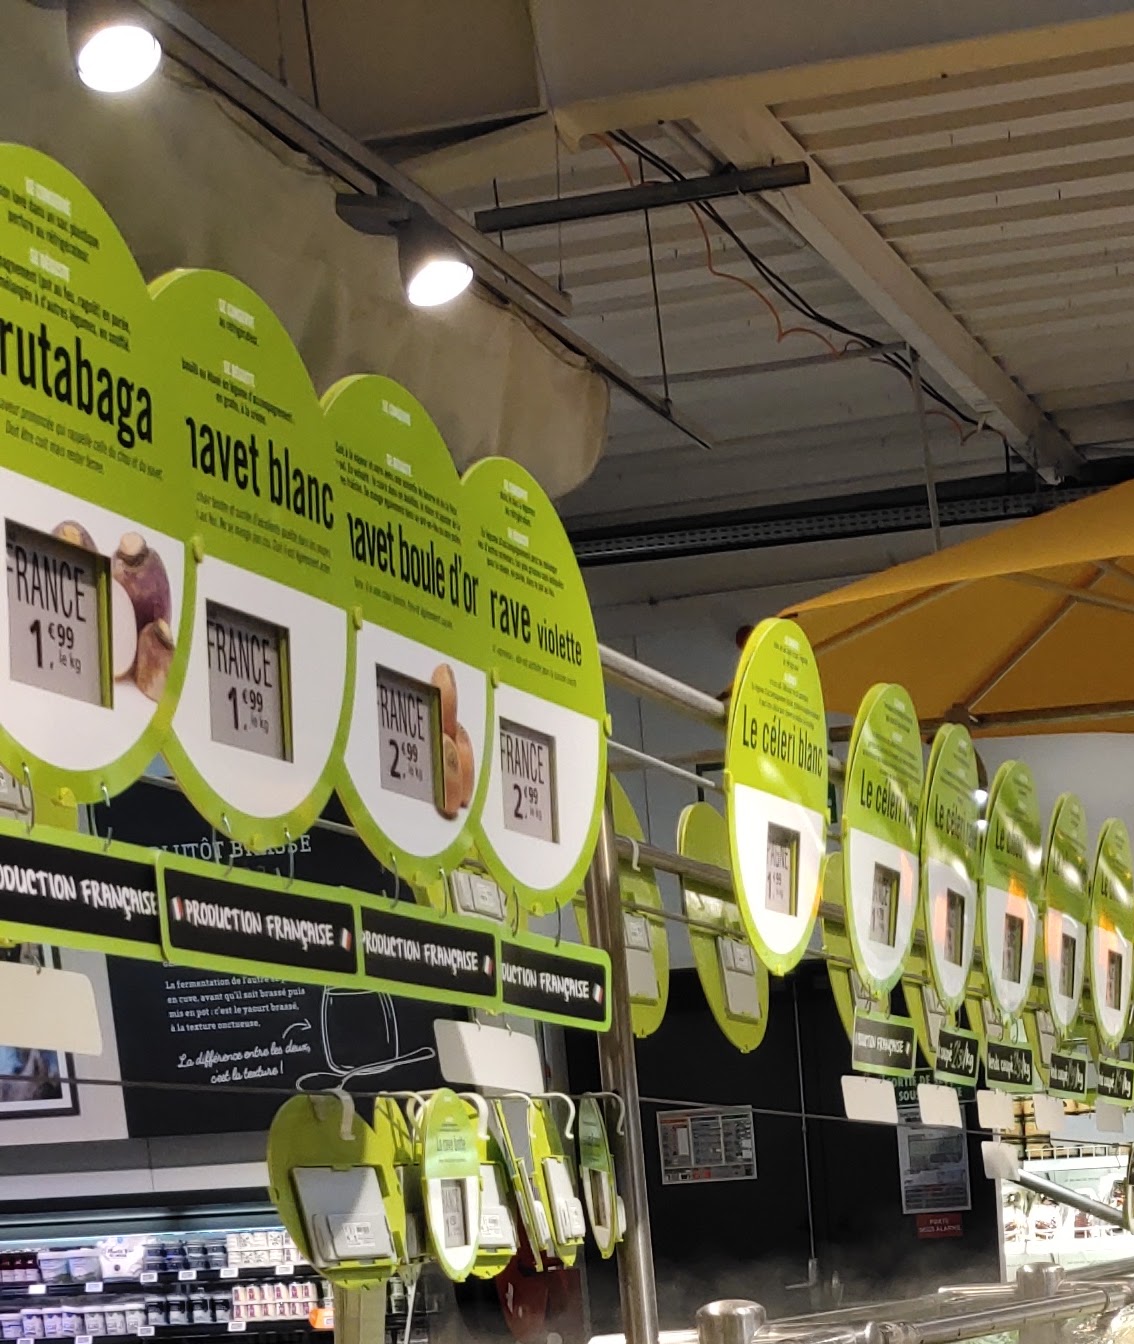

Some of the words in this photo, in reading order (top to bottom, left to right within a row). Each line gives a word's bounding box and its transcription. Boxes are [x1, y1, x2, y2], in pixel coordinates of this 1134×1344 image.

[0, 320, 153, 450] rutabaga
[268, 438, 335, 531] blanc
[399, 522, 446, 600] boule
[450, 552, 479, 618] d'or
[206, 619, 273, 688] FRANCE
[490, 588, 532, 645] rave
[537, 617, 583, 677] violette
[499, 732, 545, 785] FRANCE
[742, 703, 757, 750] Le
[762, 714, 795, 765] céleri
[798, 727, 823, 778] blanc
[185, 898, 263, 936] PRODUCTION
[265, 914, 335, 952] FRANÇAISE
[176, 978, 231, 989] fermentation
[423, 942, 479, 977] FRANÇAISE
[200, 993, 223, 1003] avant
[259, 987, 287, 998] brassé
[287, 987, 306, 998] puis
[539, 970, 590, 1003] FRANÇAISE
[168, 1009, 184, 1018] mis
[185, 1021, 217, 1030] texture
[195, 1049, 243, 1068] différence
[243, 1046, 269, 1059] entre
[270, 1041, 283, 1056] les
